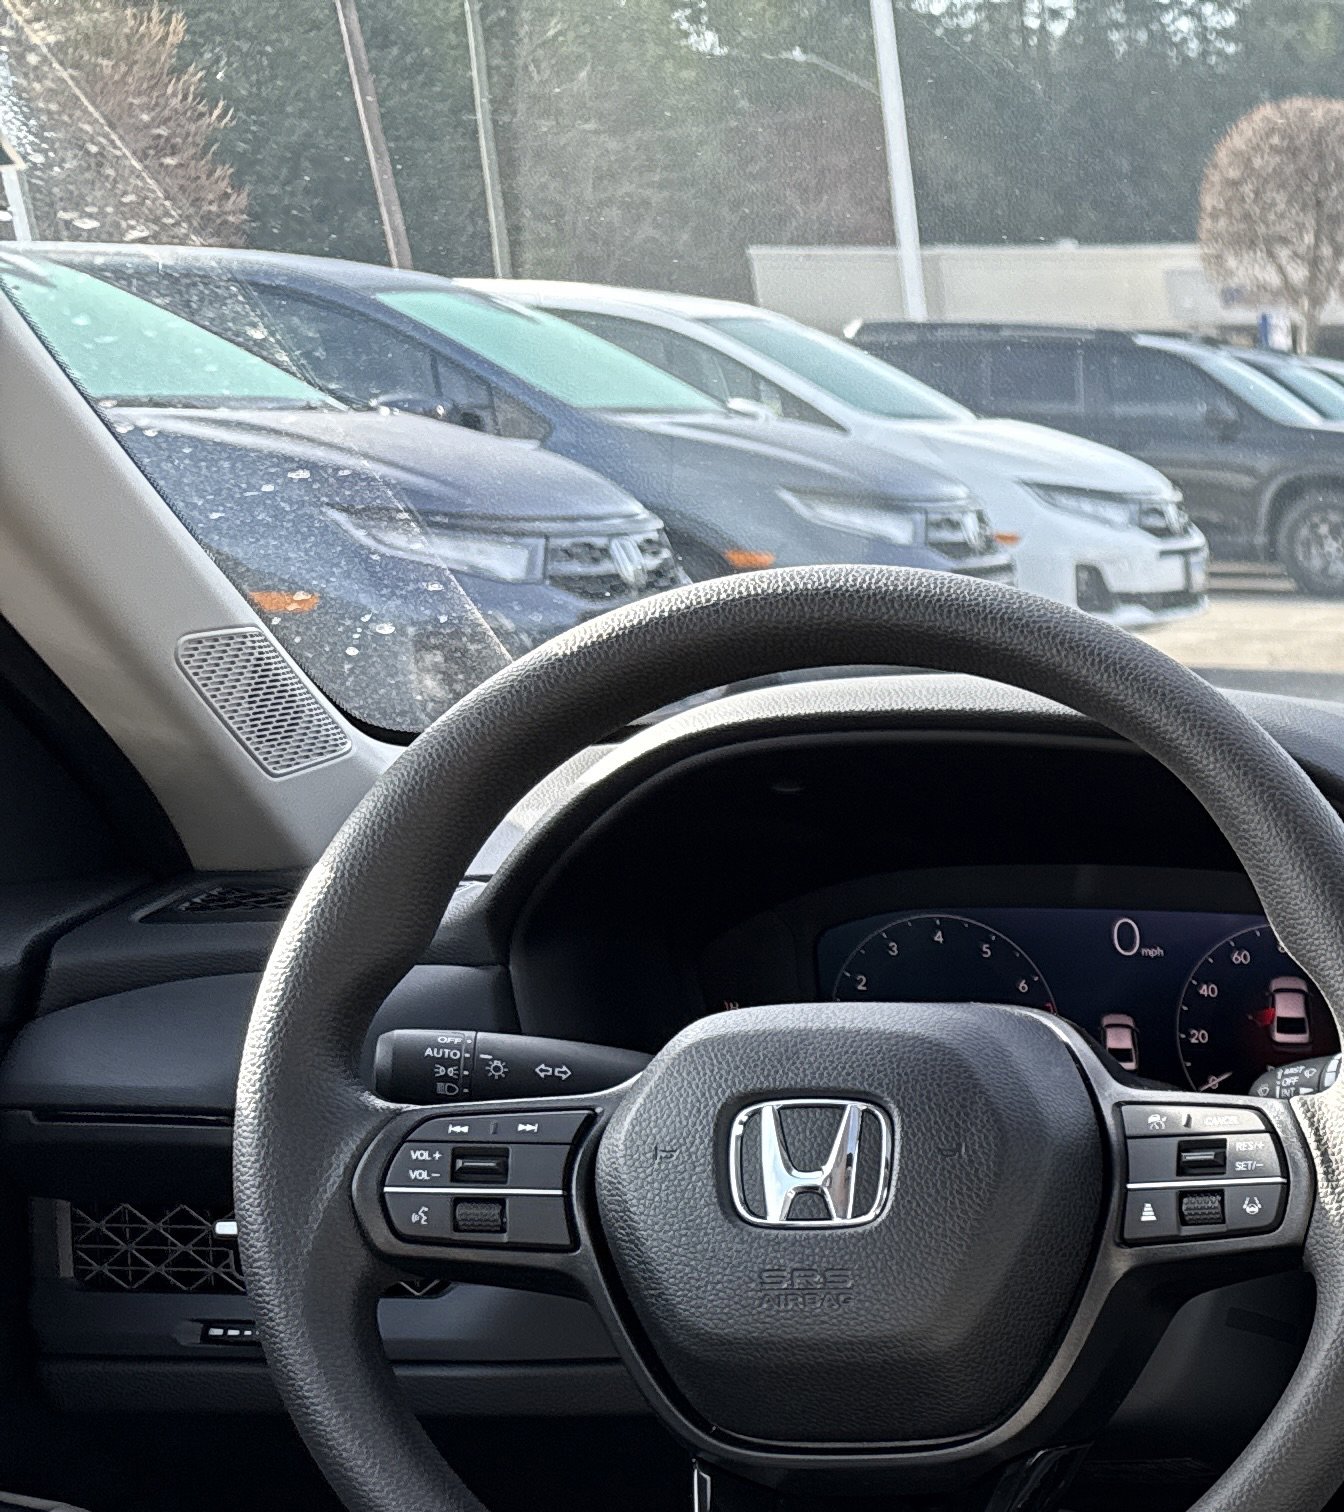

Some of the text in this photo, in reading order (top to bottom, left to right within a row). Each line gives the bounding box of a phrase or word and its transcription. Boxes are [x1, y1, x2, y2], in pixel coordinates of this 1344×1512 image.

[933, 930, 944, 944] 4
[1112, 917, 1141, 957] 0
[888, 942, 899, 957] 3
[981, 943, 993, 958] 5
[1141, 945, 1165, 959] mph
[1231, 949, 1251, 965] 60
[856, 975, 868, 991] 2
[1018, 979, 1029, 993] 6
[1198, 983, 1219, 999] 40
[437, 1036, 462, 1045] OFF
[1189, 1029, 1209, 1044] 20
[424, 1047, 461, 1059] AUTO
[1281, 1076, 1299, 1087] OFF
